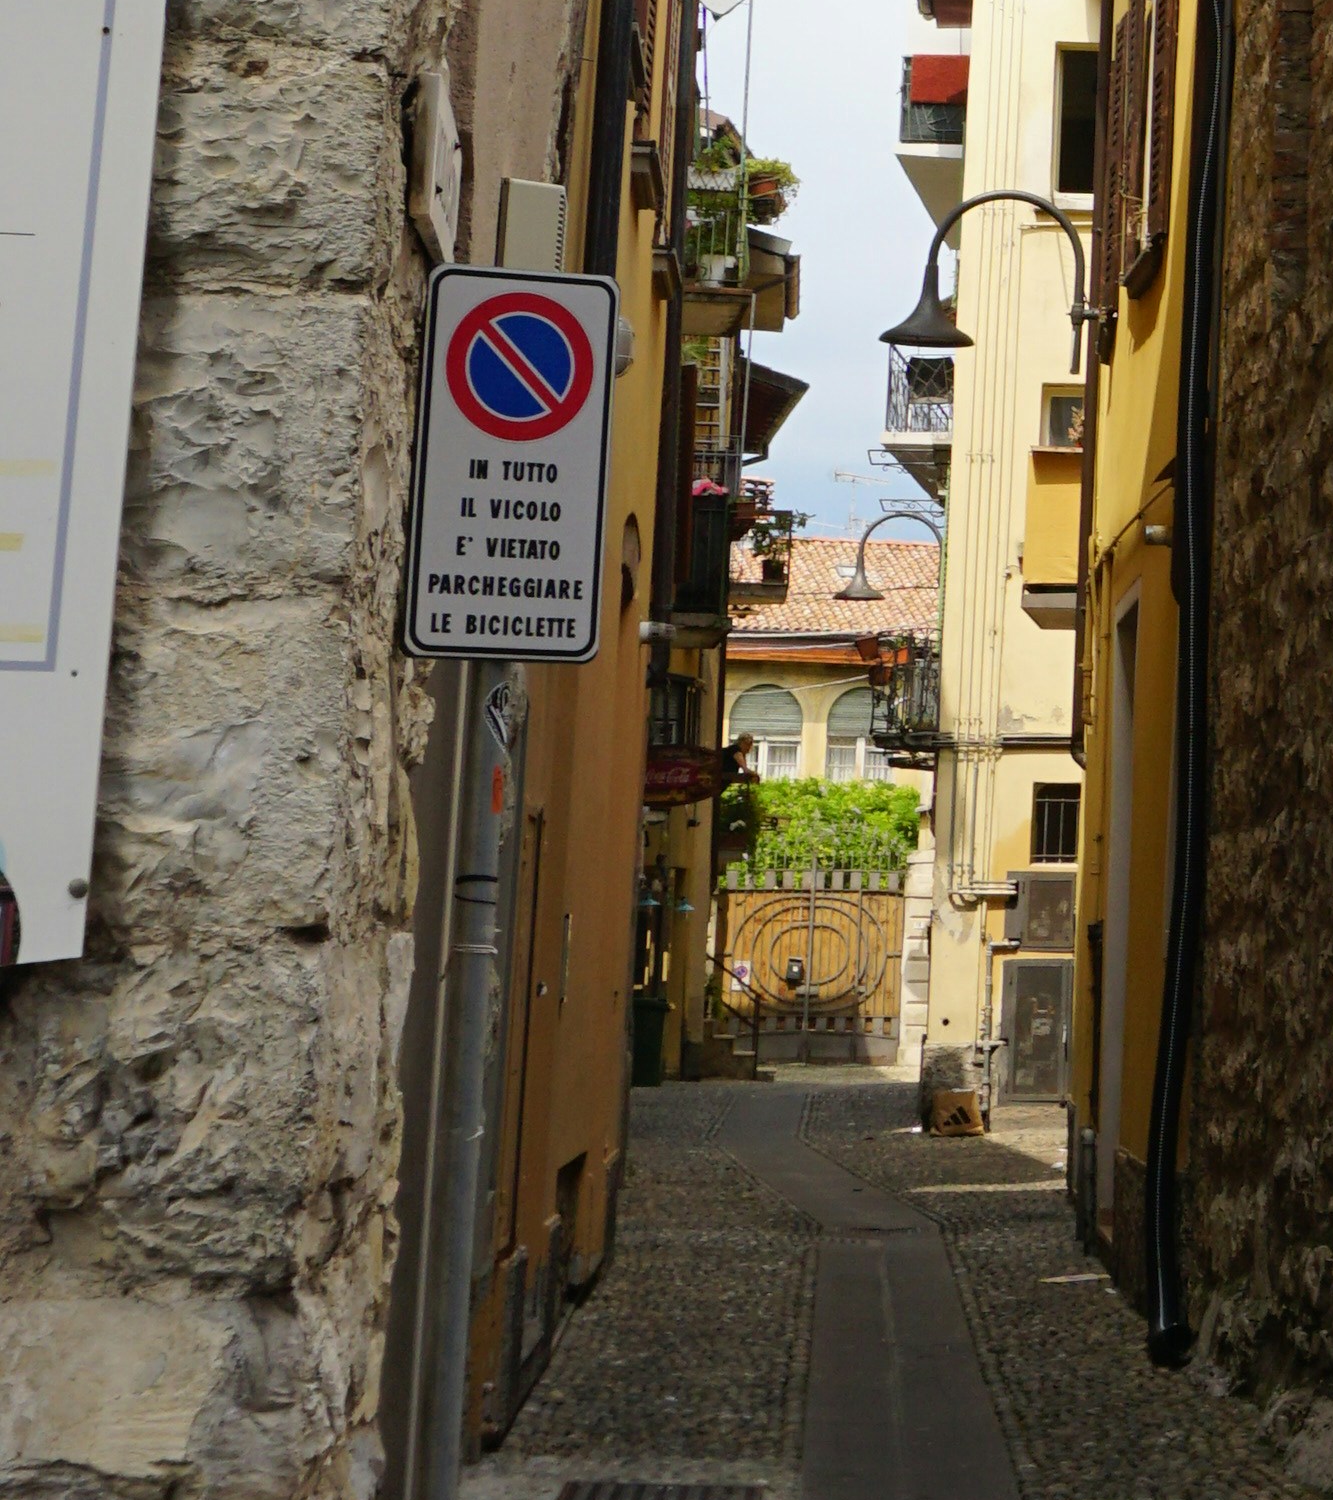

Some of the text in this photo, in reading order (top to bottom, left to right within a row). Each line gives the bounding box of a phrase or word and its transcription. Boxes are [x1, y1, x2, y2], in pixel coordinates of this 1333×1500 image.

[469, 459, 558, 484] IN TUTTO
[460, 497, 562, 522] IL VICOLO
[456, 536, 561, 561] E' VIETATO
[428, 573, 583, 600] PARCHEGGIARE
[430, 612, 576, 639] LE BICICLETTE
